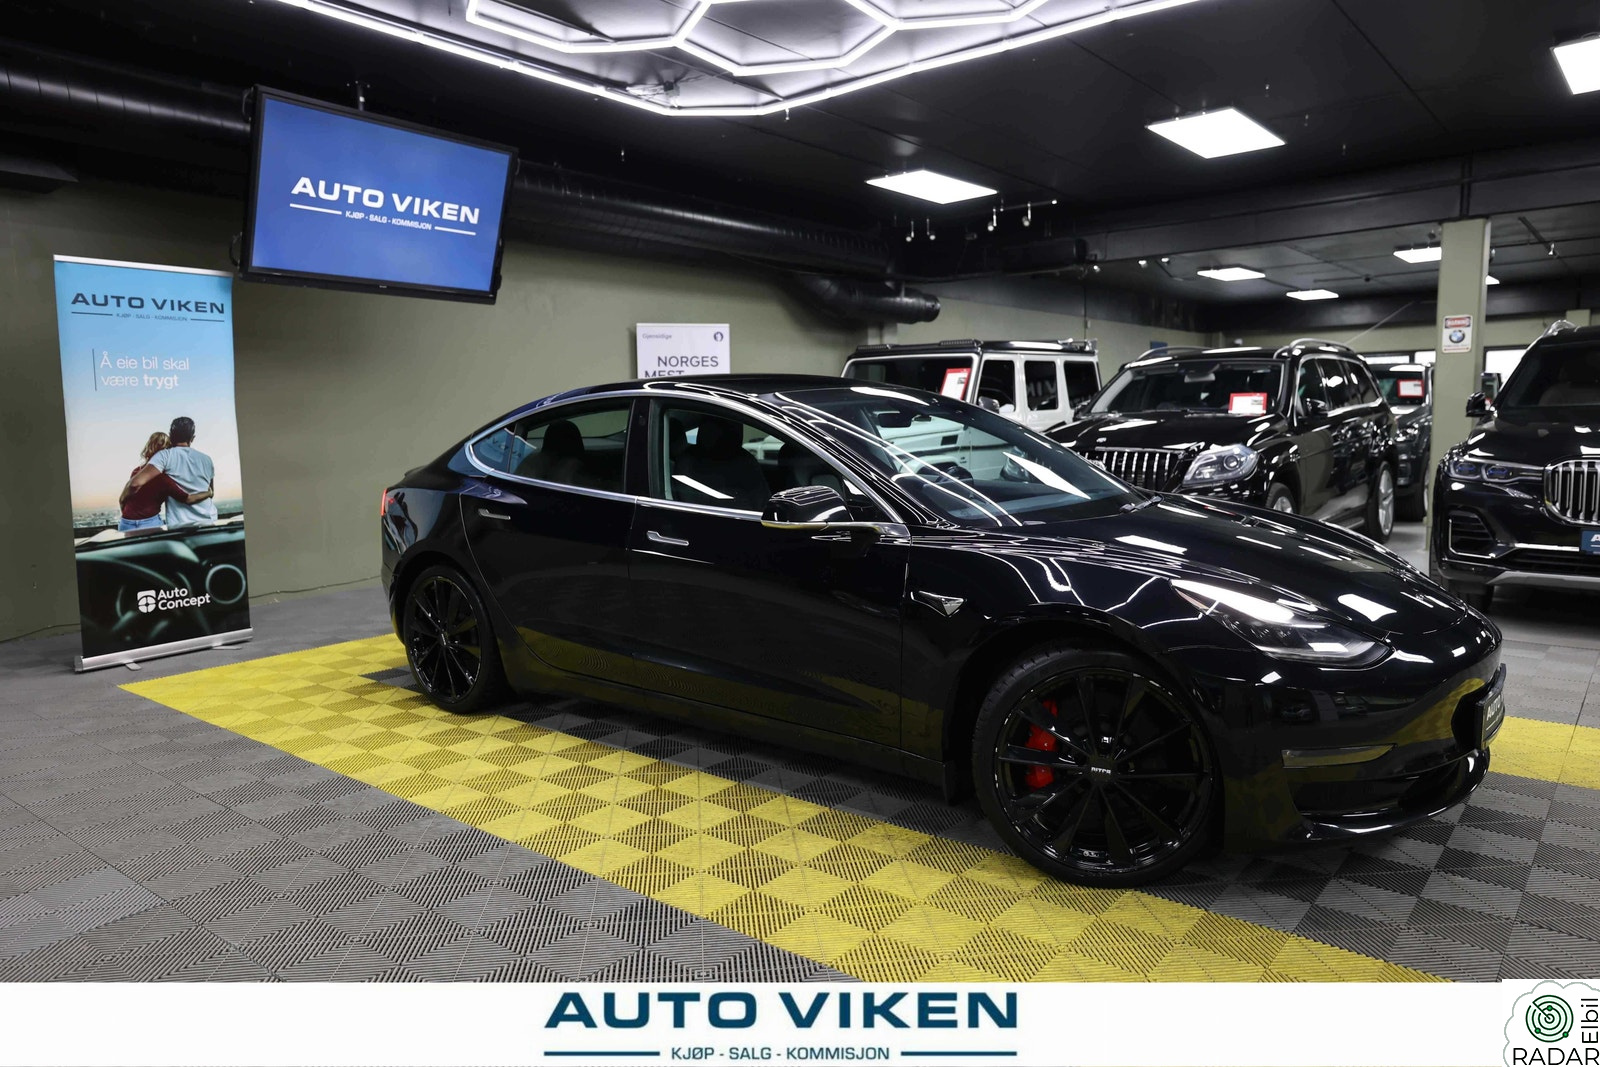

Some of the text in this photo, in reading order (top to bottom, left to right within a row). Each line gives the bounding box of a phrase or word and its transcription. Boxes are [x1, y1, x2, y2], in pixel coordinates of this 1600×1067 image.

[290, 176, 480, 225] AUTO VIKEN
[369, 214, 387, 223] SALG
[391, 217, 432, 230] KOMMISJON
[71, 292, 225, 314] AUTO VIKEN
[100, 350, 190, 371] Å eie bil skal
[657, 355, 719, 368] NORGES
[101, 373, 180, 390] være trygt
[157, 587, 188, 600] Auto
[158, 593, 211, 610] Concept
